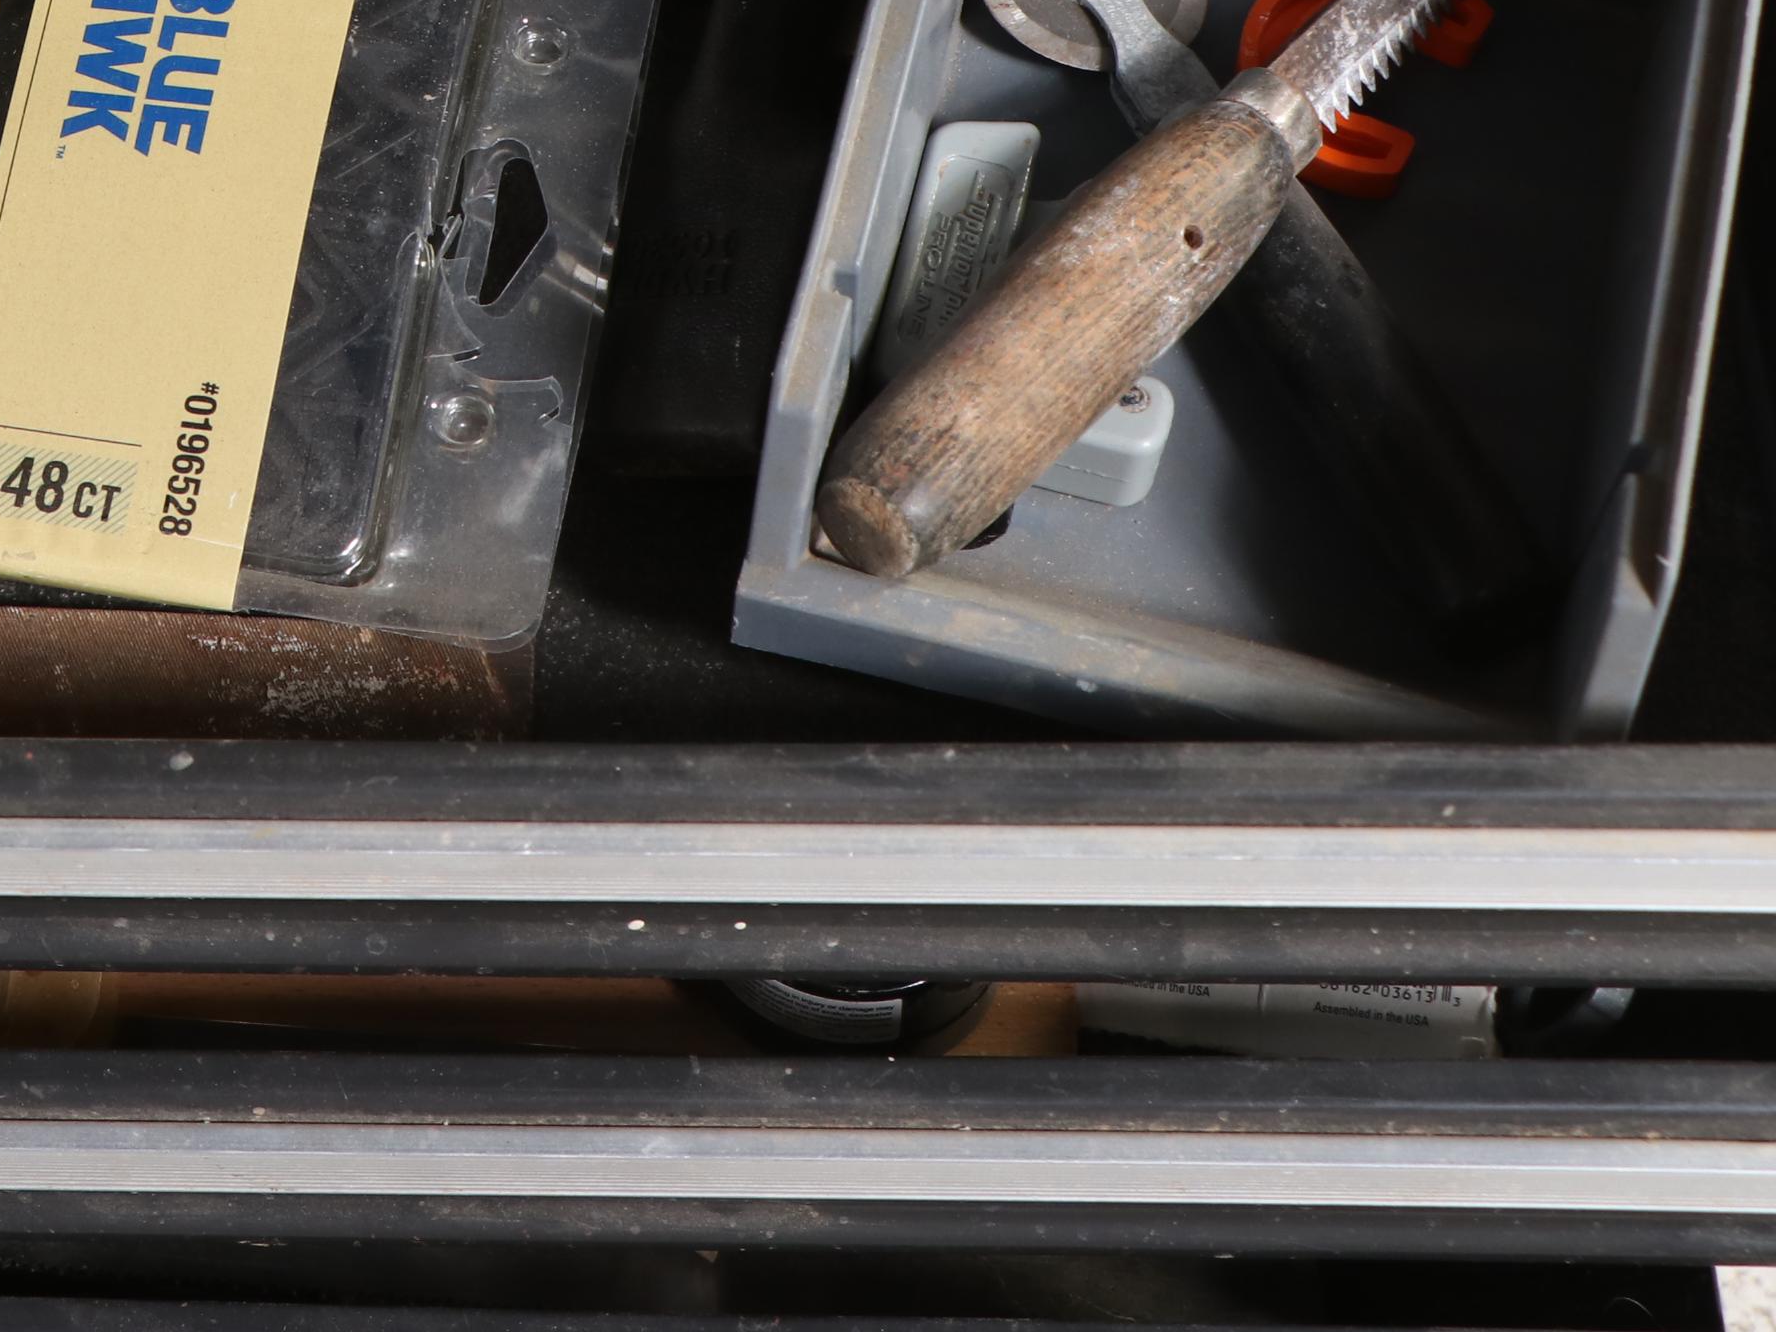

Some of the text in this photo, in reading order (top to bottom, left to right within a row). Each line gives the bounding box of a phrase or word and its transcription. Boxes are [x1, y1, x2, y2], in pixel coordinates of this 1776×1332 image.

[158, 382, 219, 535] #0196528
[1188, 984, 1210, 997] USA
[1313, 1001, 1430, 1027] Assembled in the USA
